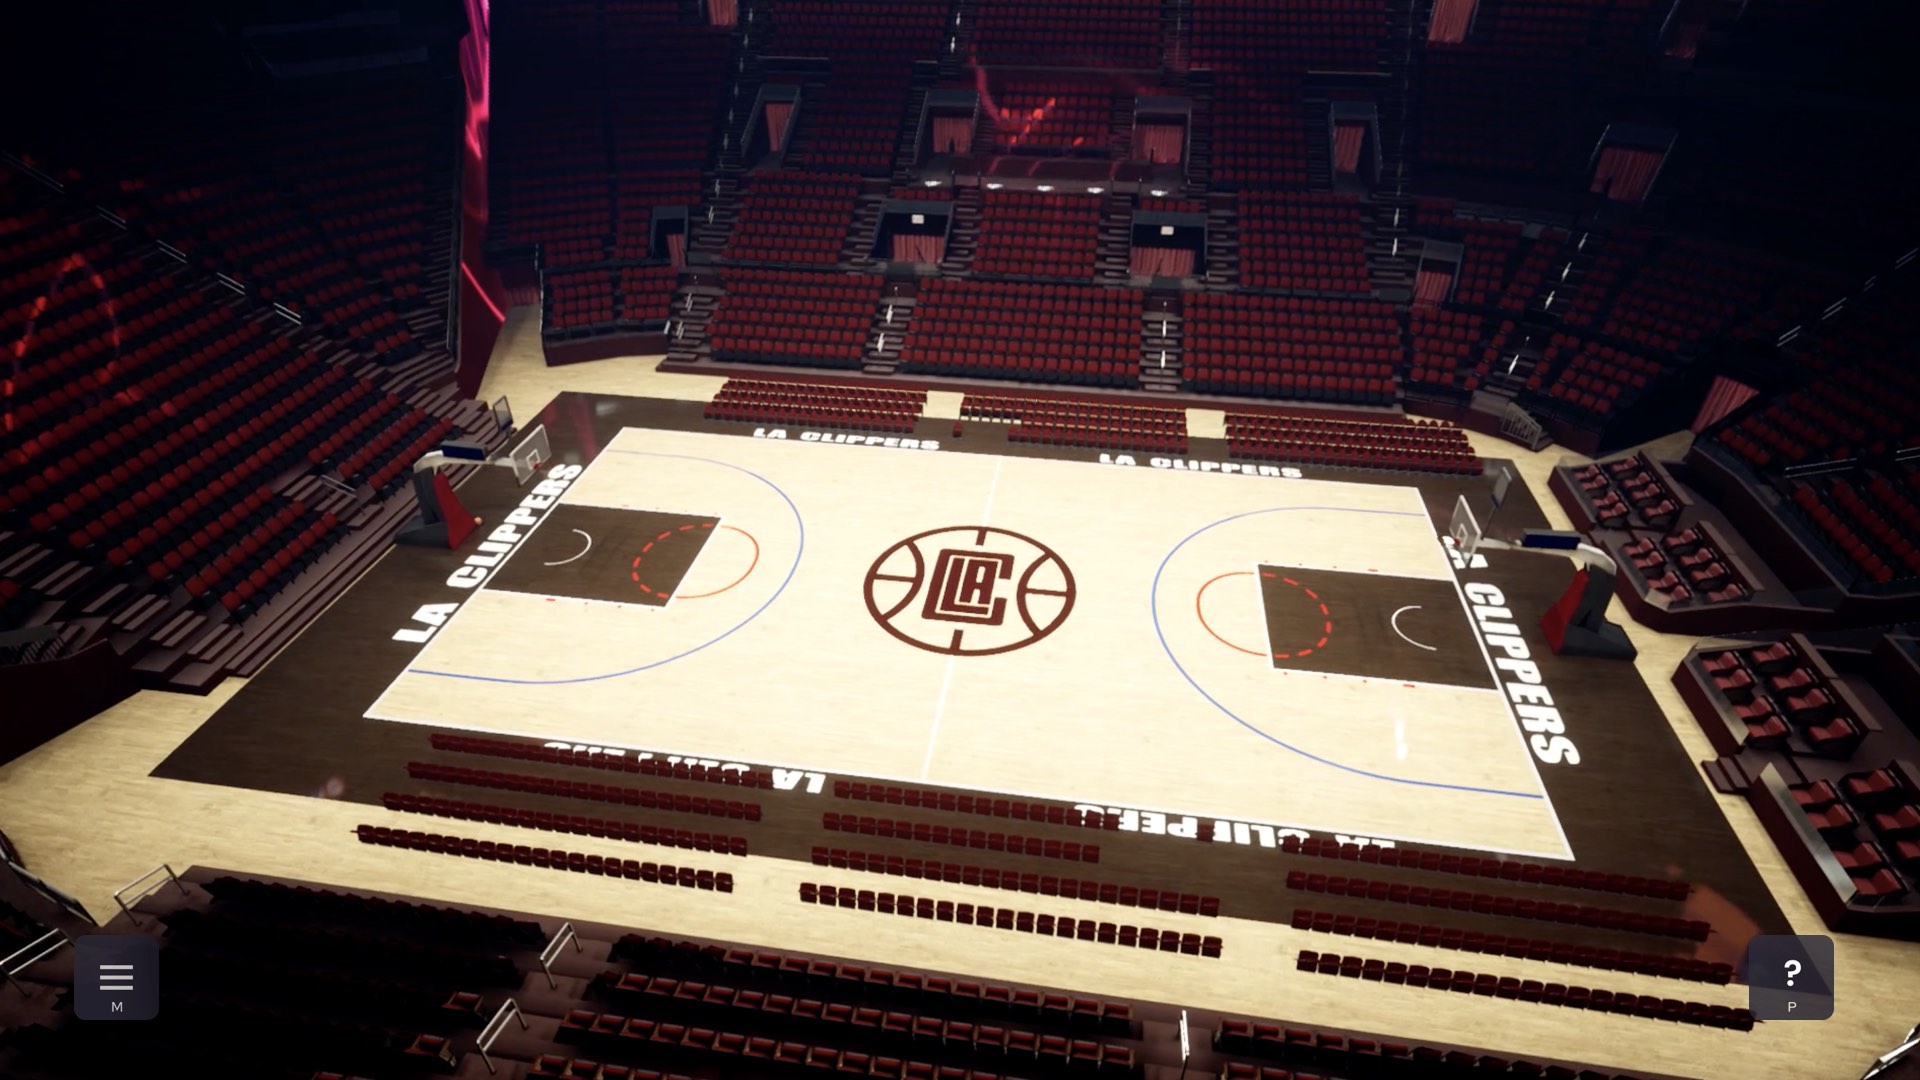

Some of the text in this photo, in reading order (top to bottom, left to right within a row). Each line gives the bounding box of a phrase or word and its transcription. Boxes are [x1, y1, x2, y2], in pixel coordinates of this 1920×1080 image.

[753, 428, 940, 450] LA CLIPPERS
[1099, 453, 1303, 479] LA CLIPPERS
[391, 464, 583, 643] LA CLIPPERS
[1464, 582, 1581, 765] CLIPPERS
[772, 768, 826, 794] LA
